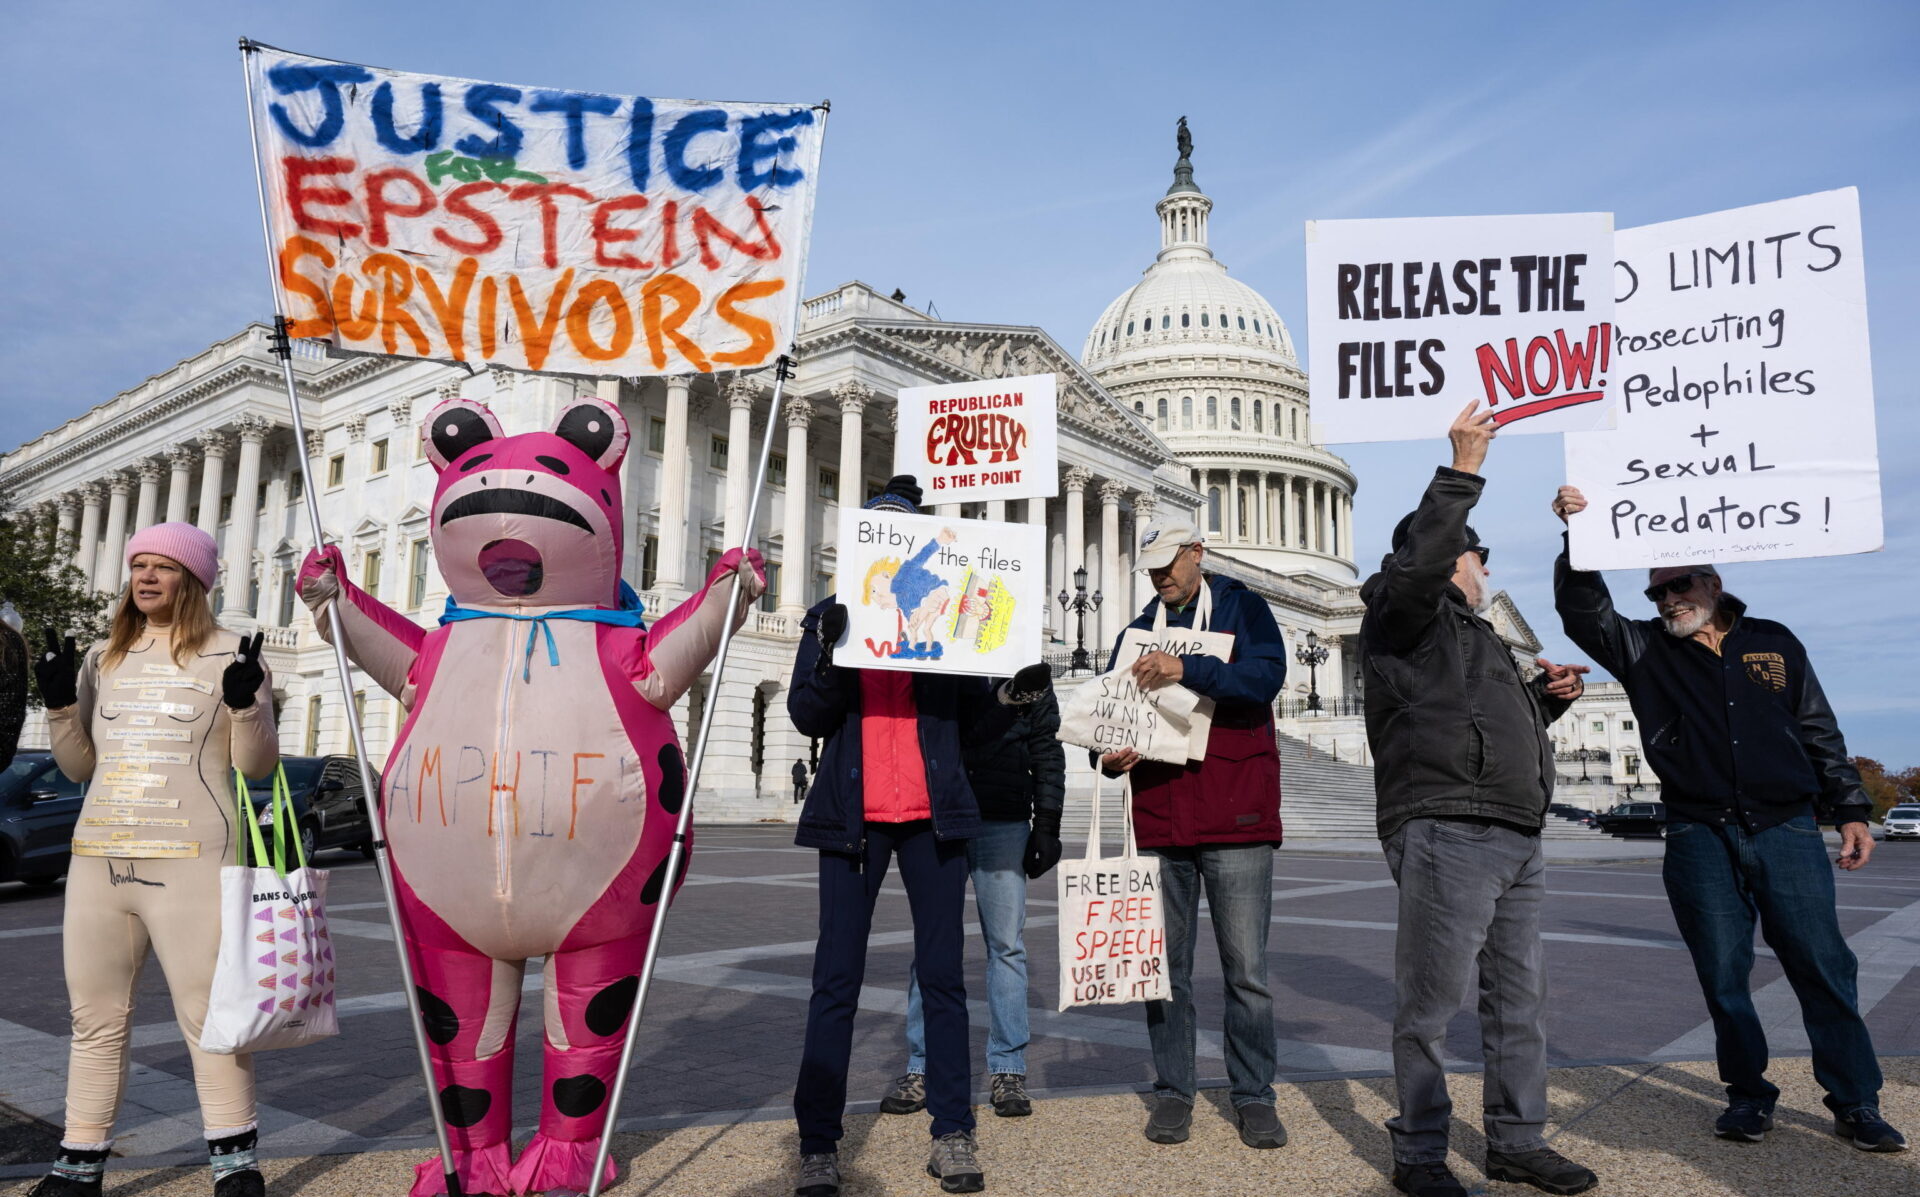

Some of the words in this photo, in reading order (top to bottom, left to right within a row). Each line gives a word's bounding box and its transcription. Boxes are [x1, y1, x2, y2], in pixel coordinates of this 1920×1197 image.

[267, 63, 813, 192] JUSTICE
[424, 150, 548, 186] FOR
[282, 157, 781, 270] EPSTEIN
[1669, 225, 1843, 292] LIMITS
[1338, 257, 1501, 320] RELEASE
[1510, 253, 1588, 313] THE
[279, 234, 785, 373] SURVIVORS
[1615, 308, 1785, 356] rosecuting
[1338, 338, 1446, 399] FILES
[1476, 322, 1611, 406] NOW!
[1622, 361, 1816, 413] Pedophiles
[929, 392, 1023, 414] REPUBLICAN
[927, 413, 1027, 466] CRUELTY
[933, 476, 946, 489] IS
[951, 474, 976, 487] THE
[982, 470, 1022, 485] POINT
[938, 547, 969, 566] the
[977, 548, 1021, 572] files
[1100, 677, 1161, 709] PANTS
[1090, 700, 1116, 719] MY
[1121, 705, 1139, 726] IN
[1147, 711, 1158, 730] IS
[1094, 724, 1139, 748] NEED
[253, 892, 280, 903] BANS
[1065, 872, 1121, 898] FREE
[1087, 897, 1152, 926] FREE
[1075, 928, 1163, 960] SPEECH
[1071, 964, 1106, 985] USE
[1116, 959, 1132, 979] IT
[1140, 957, 1161, 977] OR
[1074, 983, 1116, 1002] LOSE
